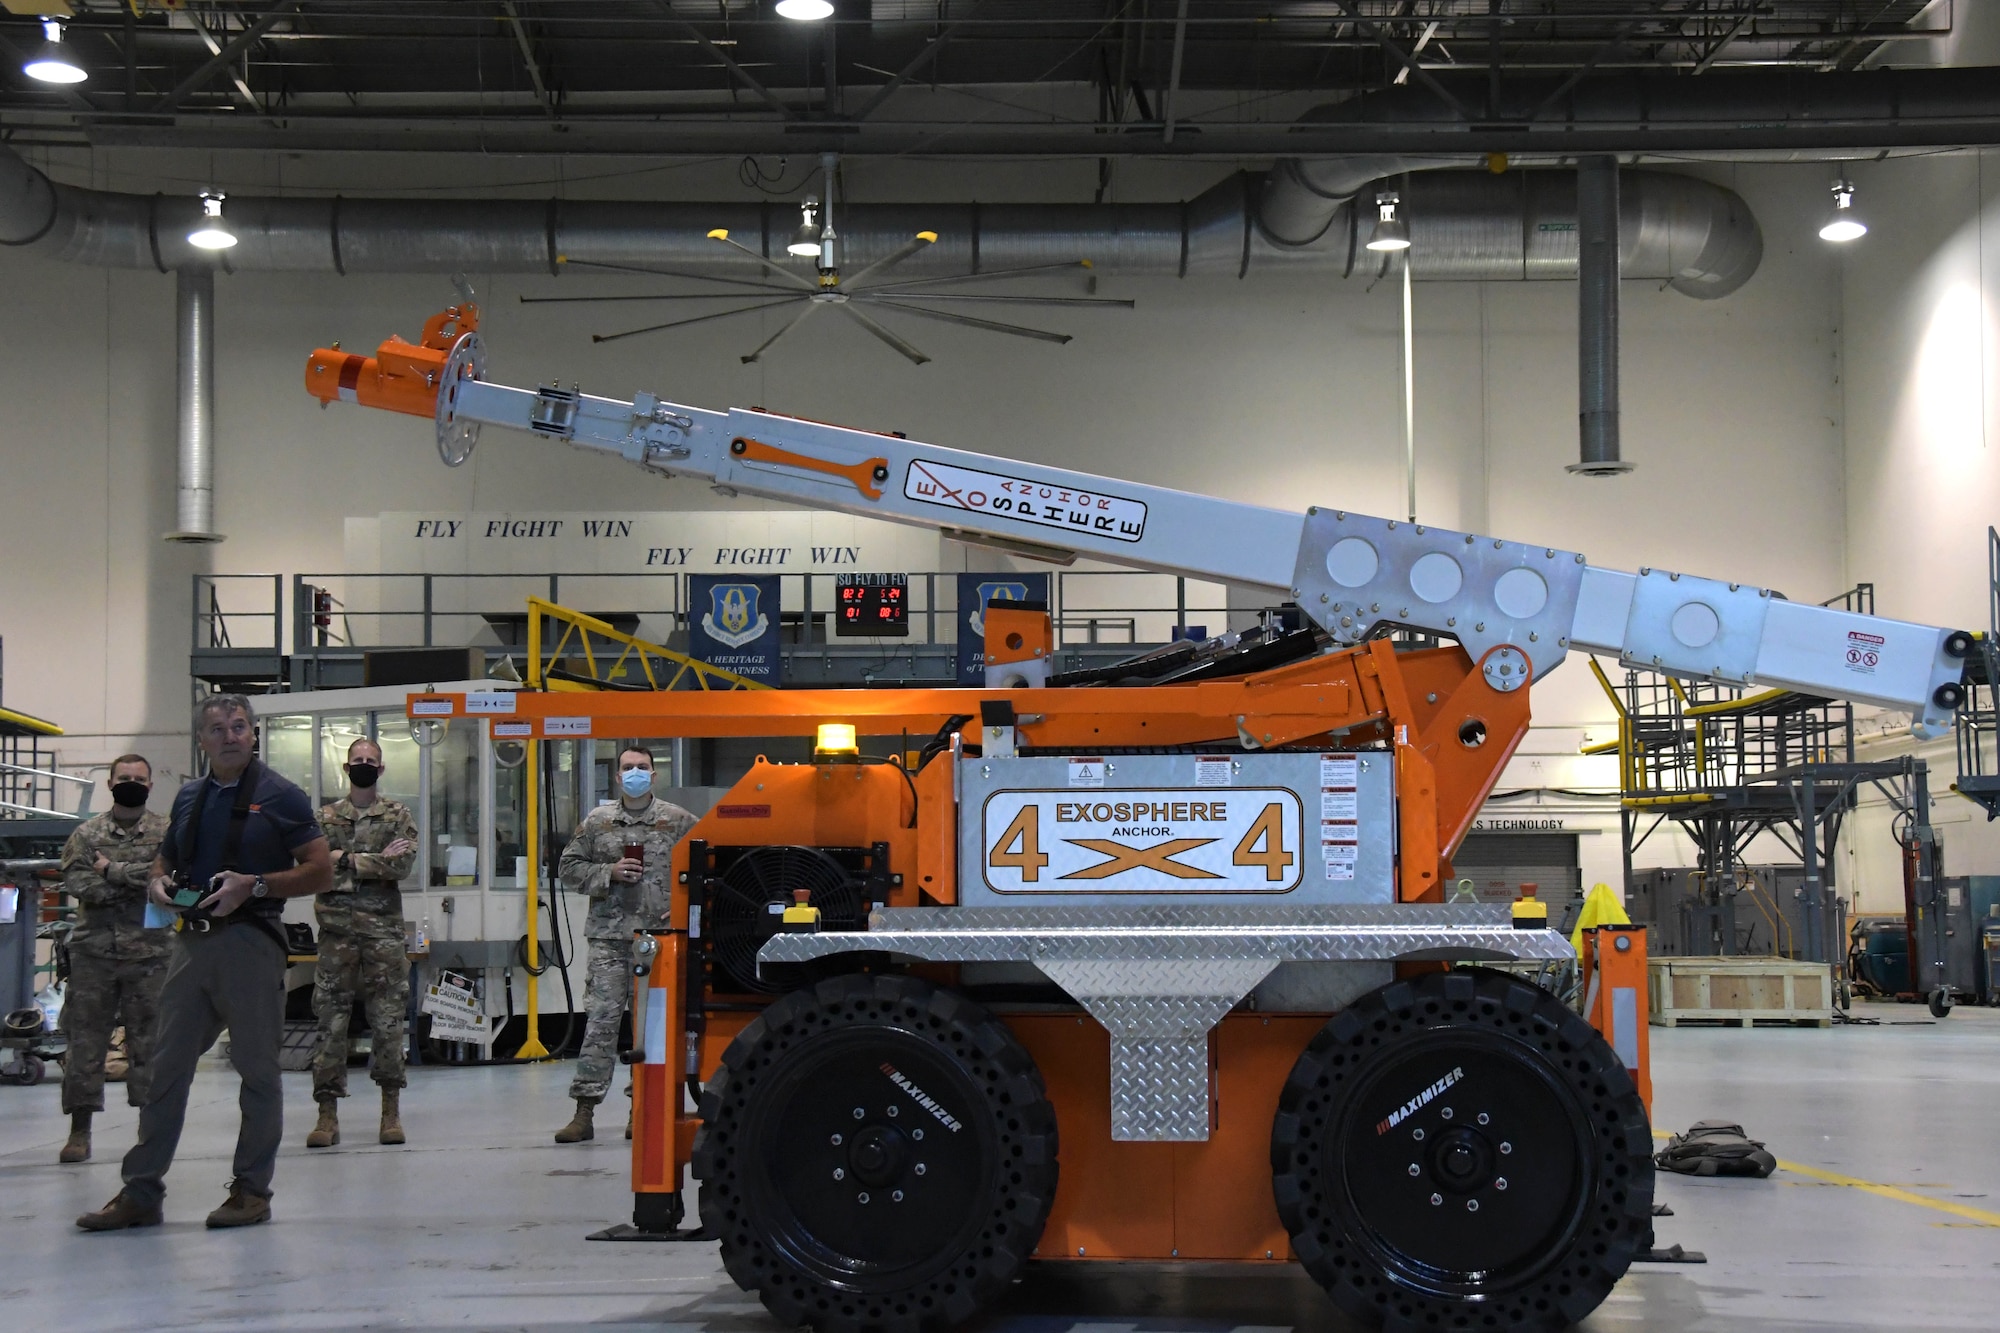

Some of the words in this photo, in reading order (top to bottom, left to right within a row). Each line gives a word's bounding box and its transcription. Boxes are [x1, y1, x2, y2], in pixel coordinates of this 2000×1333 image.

[1001, 481, 1111, 510] ANCHOR
[415, 520, 463, 538] FLY
[484, 520, 563, 538] FIGHT
[582, 520, 634, 538] WIN
[646, 547, 693, 565] FLY
[714, 547, 792, 565] FIGHT
[810, 547, 861, 564] WIN
[855, 573, 872, 585] FLY
[875, 573, 887, 585] TO
[891, 573, 907, 585] FLY
[704, 655, 711, 663] A
[714, 655, 766, 664] HERITAGE
[966, 664, 976, 673] of
[1056, 802, 1228, 822] EXOSPHERE
[1488, 819, 1564, 830] TECHNOLOGY
[439, 988, 467, 1002] CAUTION
[889, 1071, 962, 1133] MAXIMIZER
[1387, 1066, 1465, 1128] MAXIMIZER
